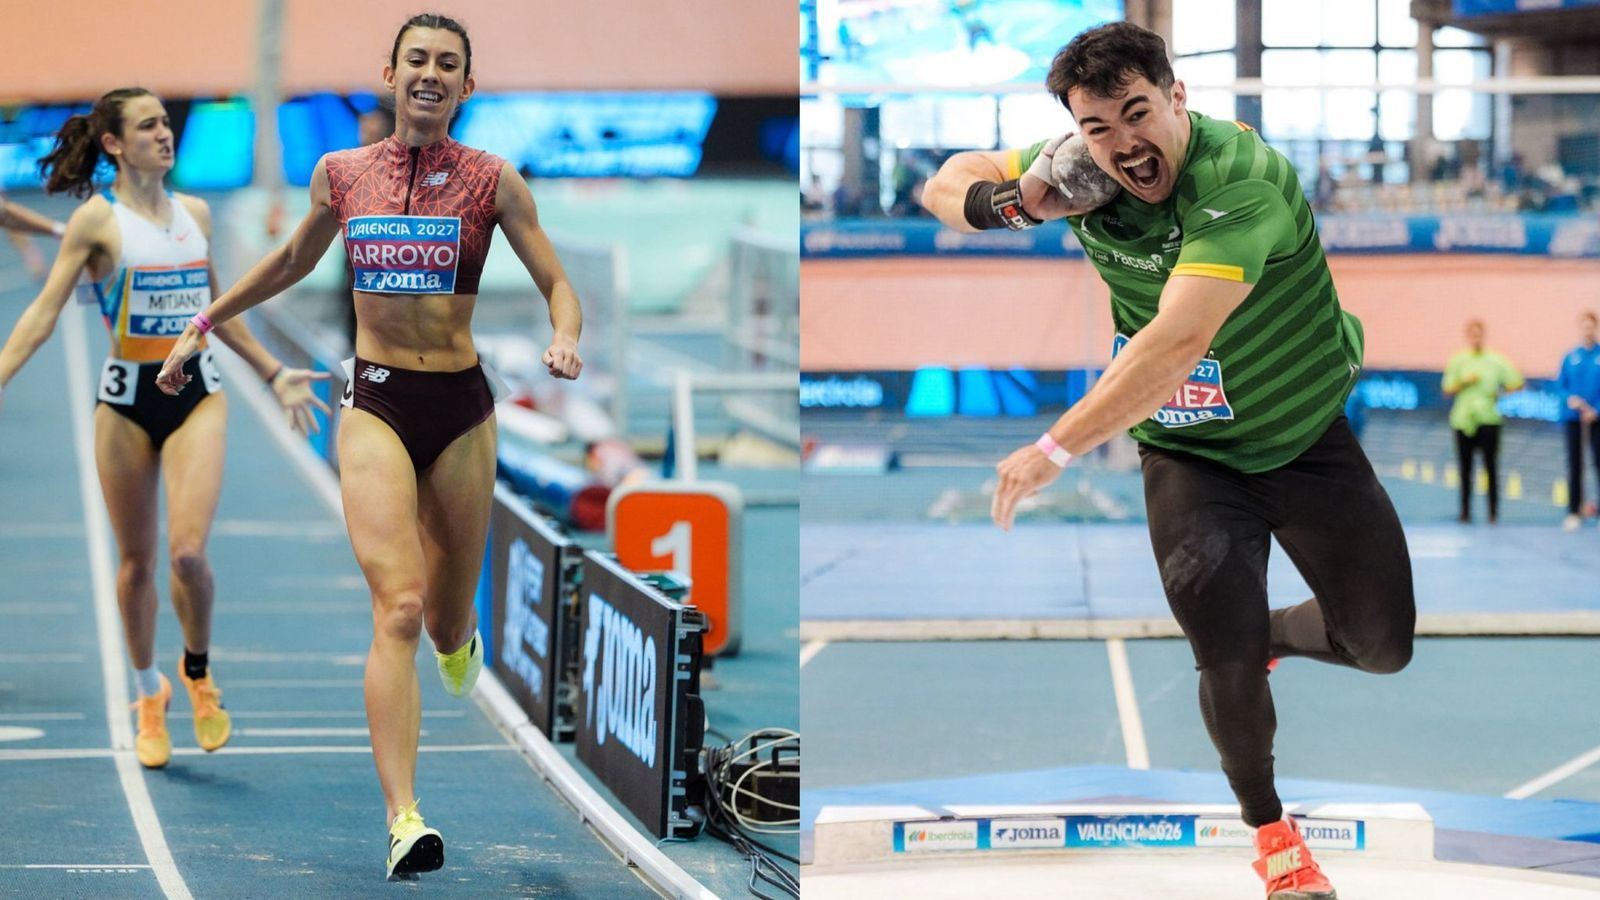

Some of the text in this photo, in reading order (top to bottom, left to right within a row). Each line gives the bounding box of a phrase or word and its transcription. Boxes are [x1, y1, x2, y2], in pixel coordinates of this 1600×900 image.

[350, 223, 455, 237] VALENCIA 2027
[352, 244, 455, 267] ARROYO
[1112, 249, 1160, 273] Facsa
[105, 364, 128, 397] 3
[1150, 409, 1217, 424] oma
[651, 520, 693, 604] 1
[1077, 823, 1144, 842] VALENCIA
[1266, 846, 1303, 879] NIKE
